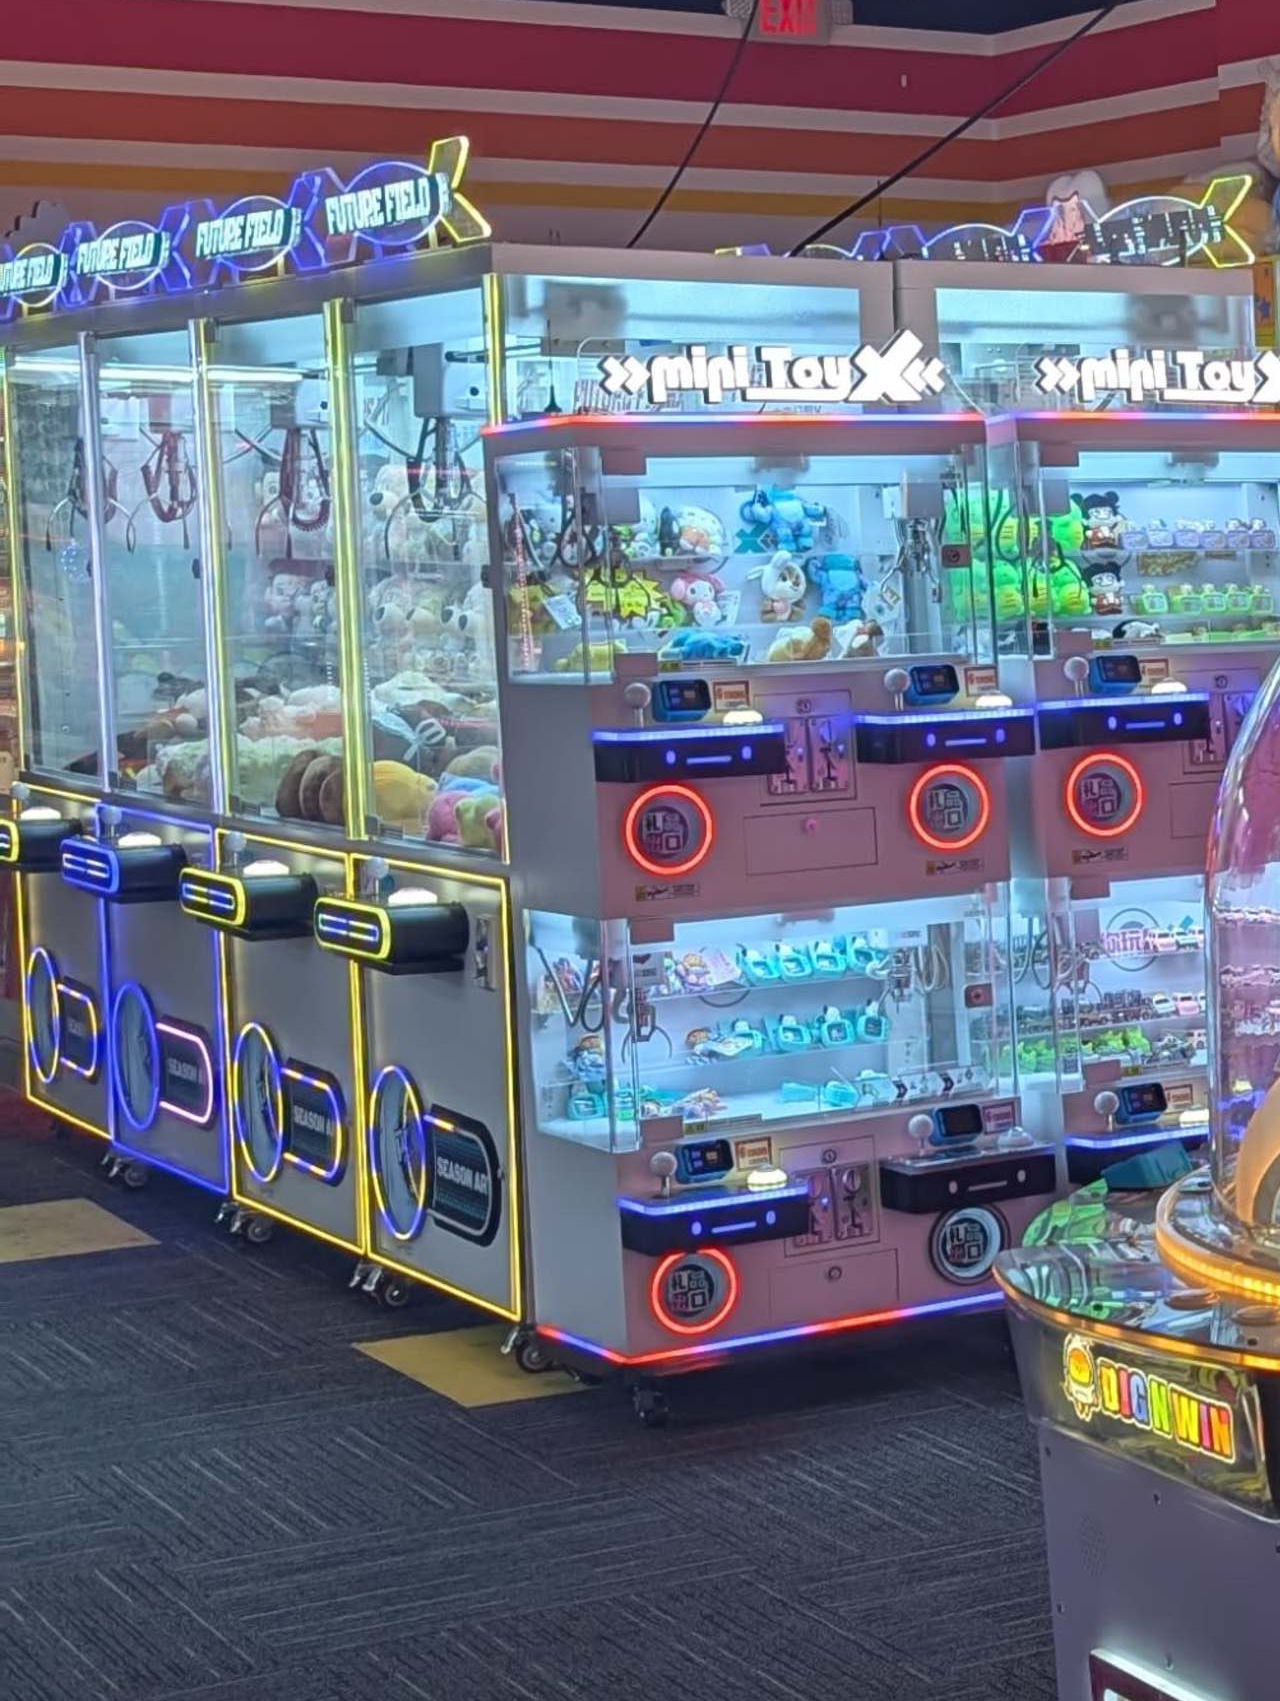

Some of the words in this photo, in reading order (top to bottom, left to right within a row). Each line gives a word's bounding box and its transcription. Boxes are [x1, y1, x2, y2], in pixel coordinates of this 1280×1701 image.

[325, 192, 384, 235] FUTURE
[384, 177, 431, 223] FIELD
[77, 237, 120, 276] FUTURE
[120, 232, 156, 270] FIELD
[195, 214, 244, 258] FUTURE
[244, 208, 285, 249] FIELD
[0, 260, 28, 294] UTURE
[649, 345, 751, 404] mini
[1078, 348, 1168, 402] mini
[436, 1155, 474, 1189] SEASON
